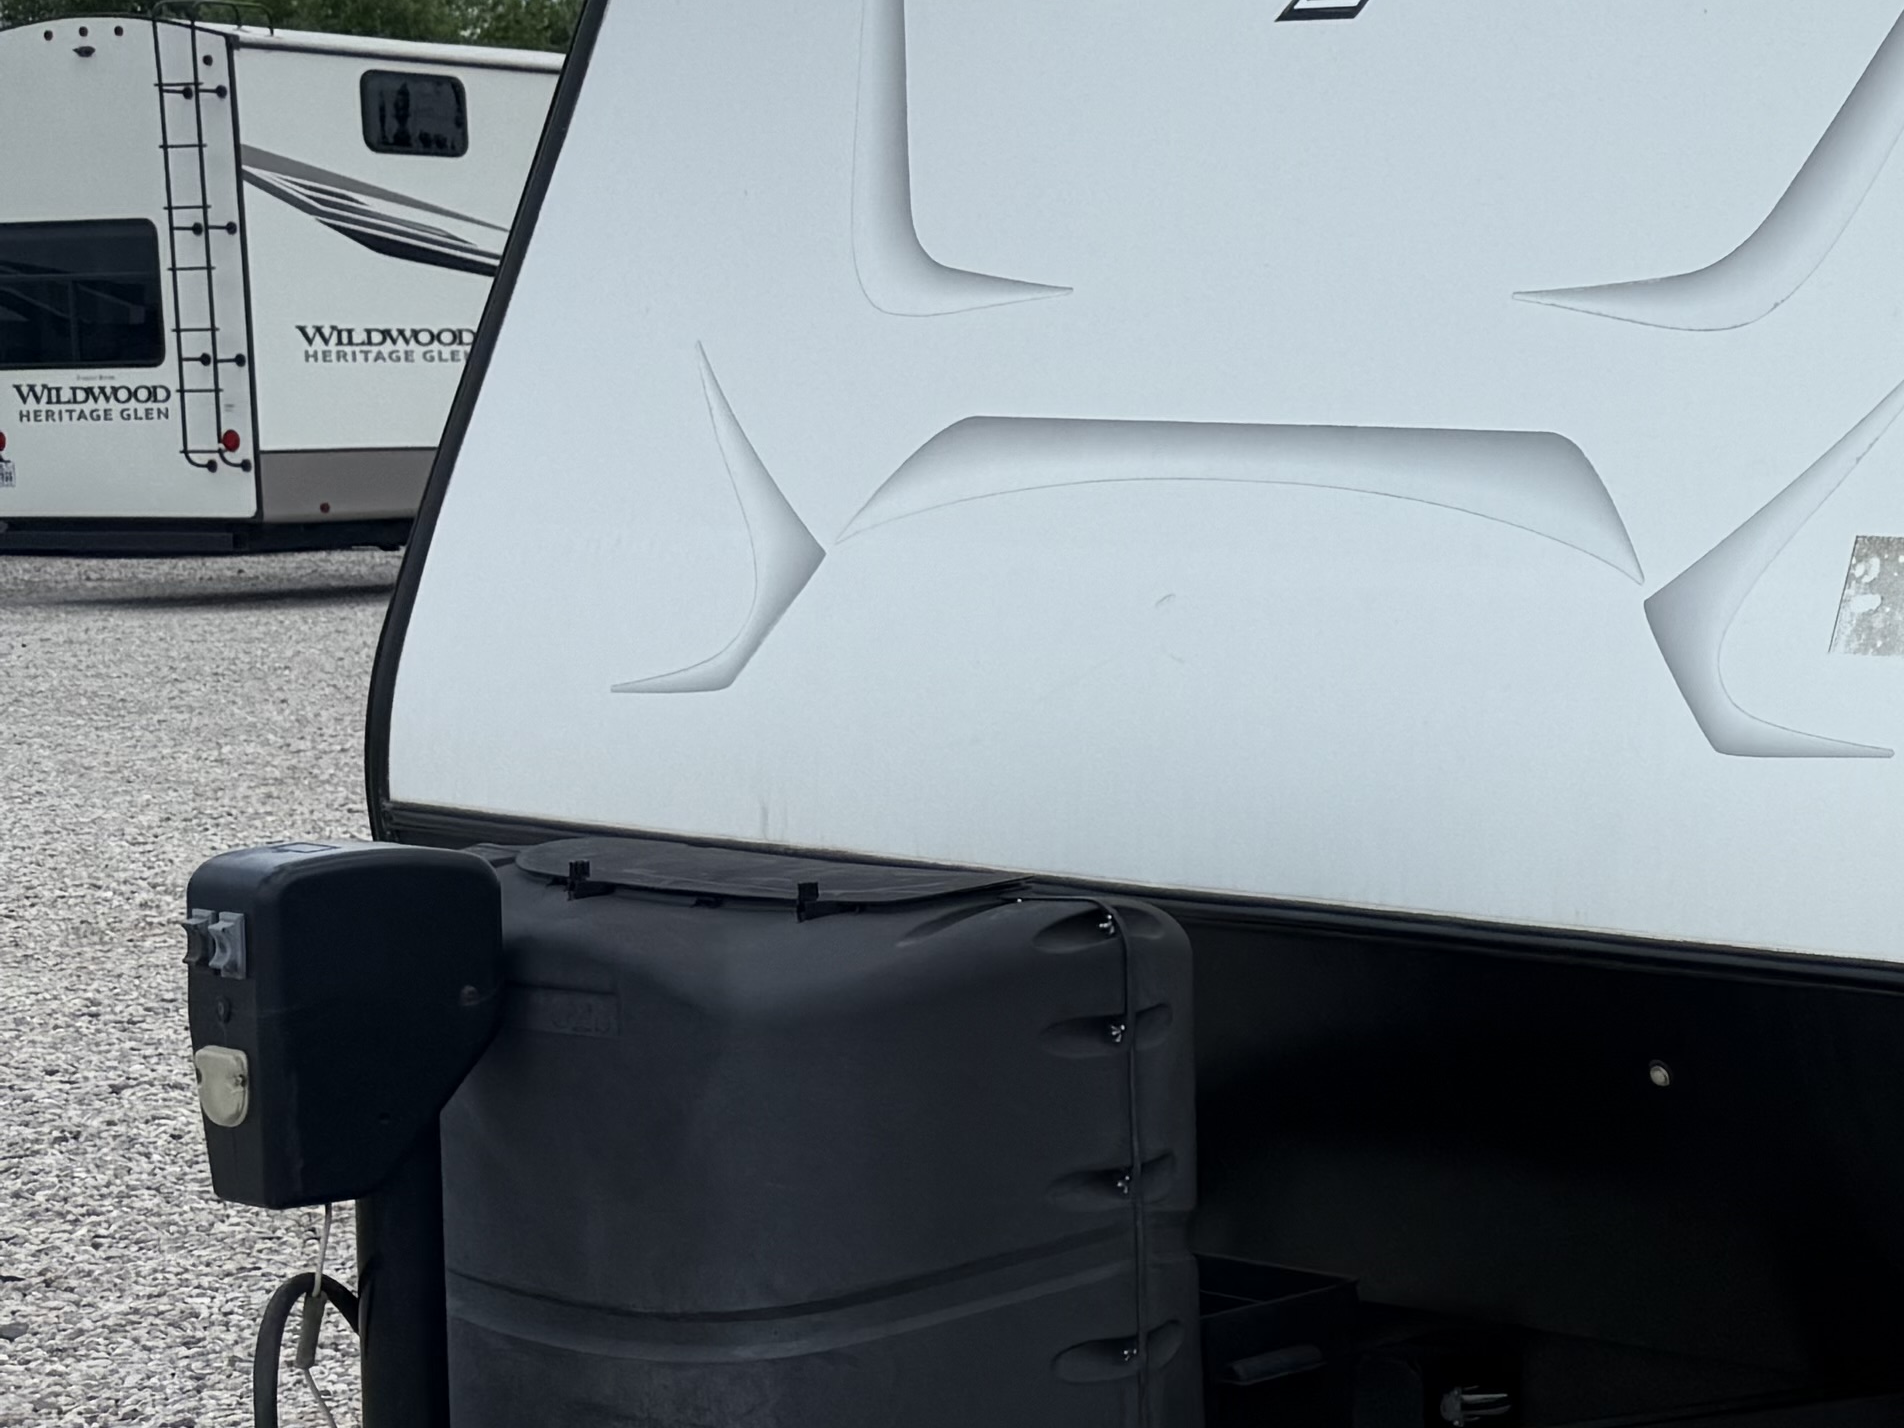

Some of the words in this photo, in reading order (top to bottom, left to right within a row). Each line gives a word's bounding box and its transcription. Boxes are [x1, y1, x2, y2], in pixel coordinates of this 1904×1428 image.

[304, 349, 415, 363] HERITAGE
[19, 408, 113, 422] HERITAGE
[120, 407, 169, 421] GLEN
